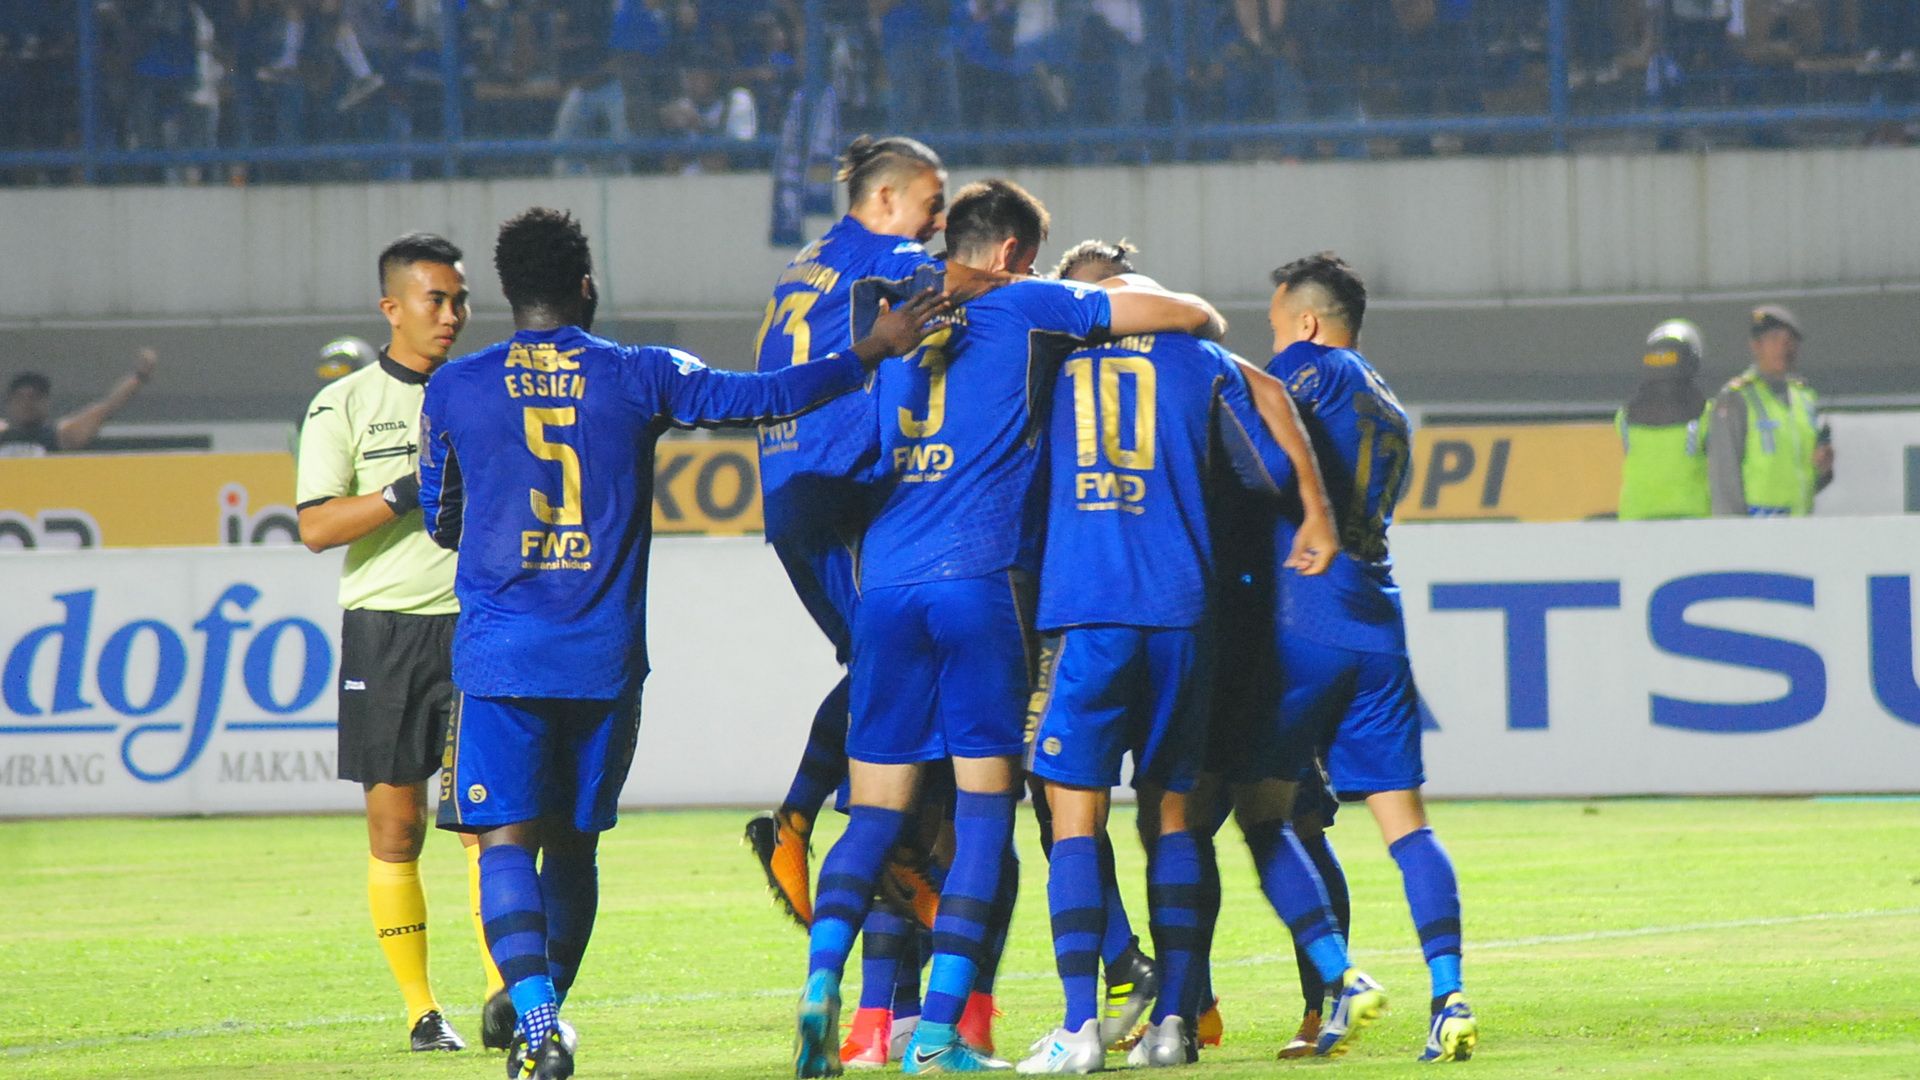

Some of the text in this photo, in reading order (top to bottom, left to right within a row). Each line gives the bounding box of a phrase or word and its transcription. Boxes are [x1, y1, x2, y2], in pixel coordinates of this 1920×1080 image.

[504, 347, 586, 373] ABC
[504, 372, 586, 400] ESSIEN
[1064, 356, 1156, 470] 10
[523, 406, 582, 526] 5
[893, 443, 954, 472] FWD
[1075, 472, 1146, 502] FWD
[1397, 438, 1511, 510] PI
[521, 530, 592, 558] FWD
[2, 583, 334, 783] dofo
